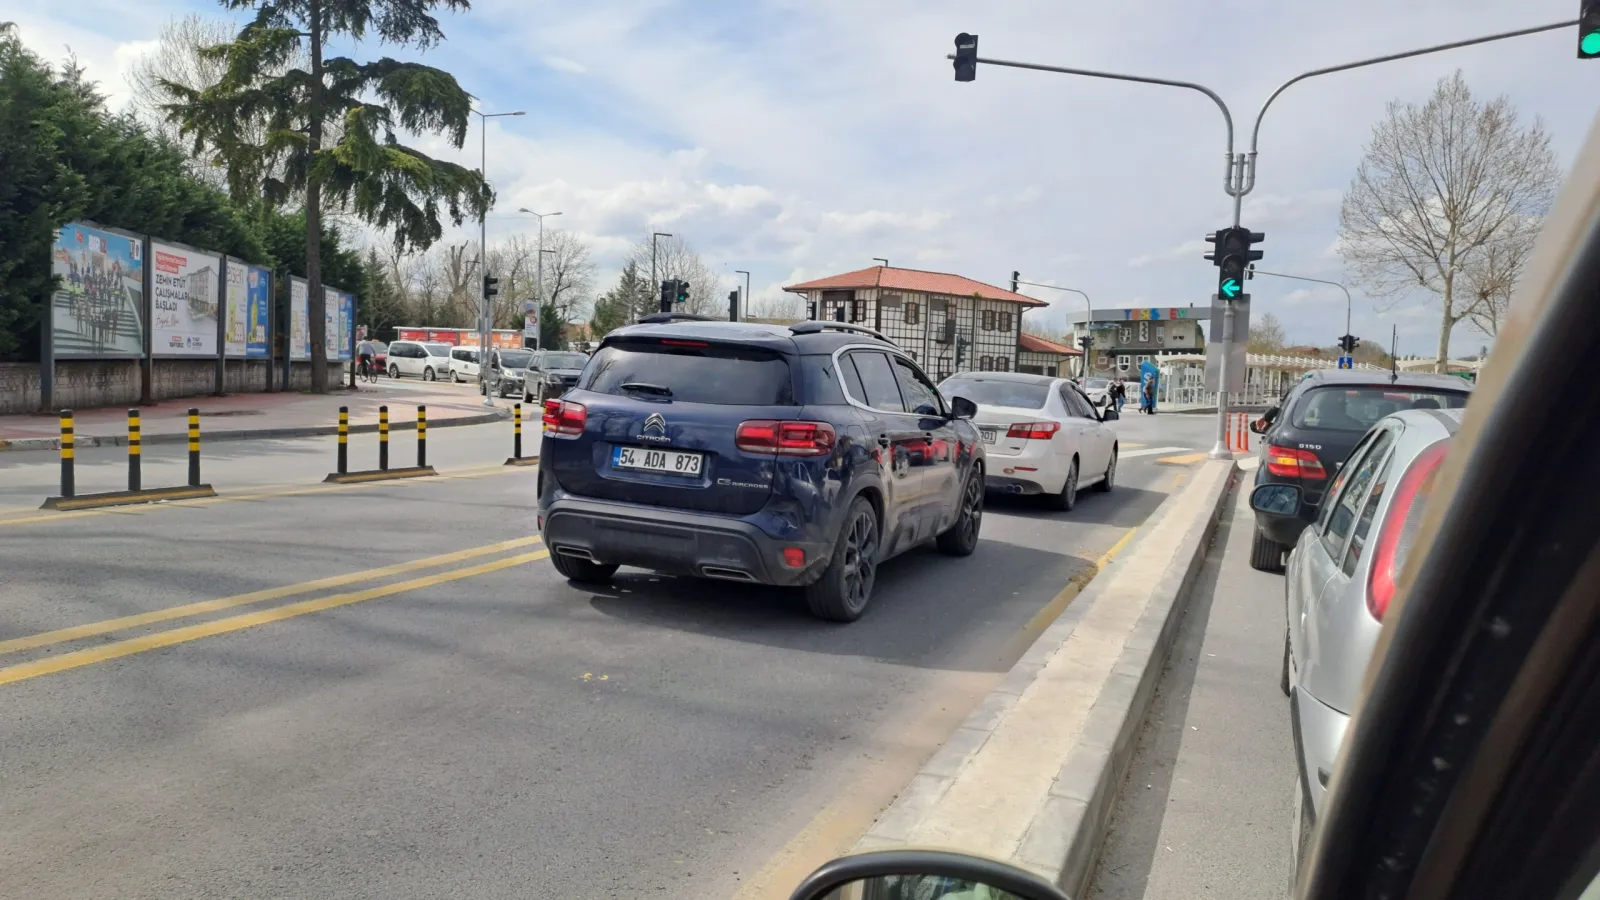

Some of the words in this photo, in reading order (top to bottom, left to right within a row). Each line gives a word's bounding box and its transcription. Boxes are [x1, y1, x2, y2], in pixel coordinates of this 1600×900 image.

[156, 274, 171, 285] ZEMİN
[173, 277, 186, 288] ETÜT
[155, 287, 189, 301] ÇALIŞMALARI
[155, 300, 178, 312] BAŞLADI
[1170, 307, 1187, 320] EV
[636, 434, 671, 442] CITROËN
[620, 449, 635, 465] 54
[643, 451, 666, 468] ADA
[675, 454, 699, 471] 873
[731, 481, 769, 489] AIRCROSS
